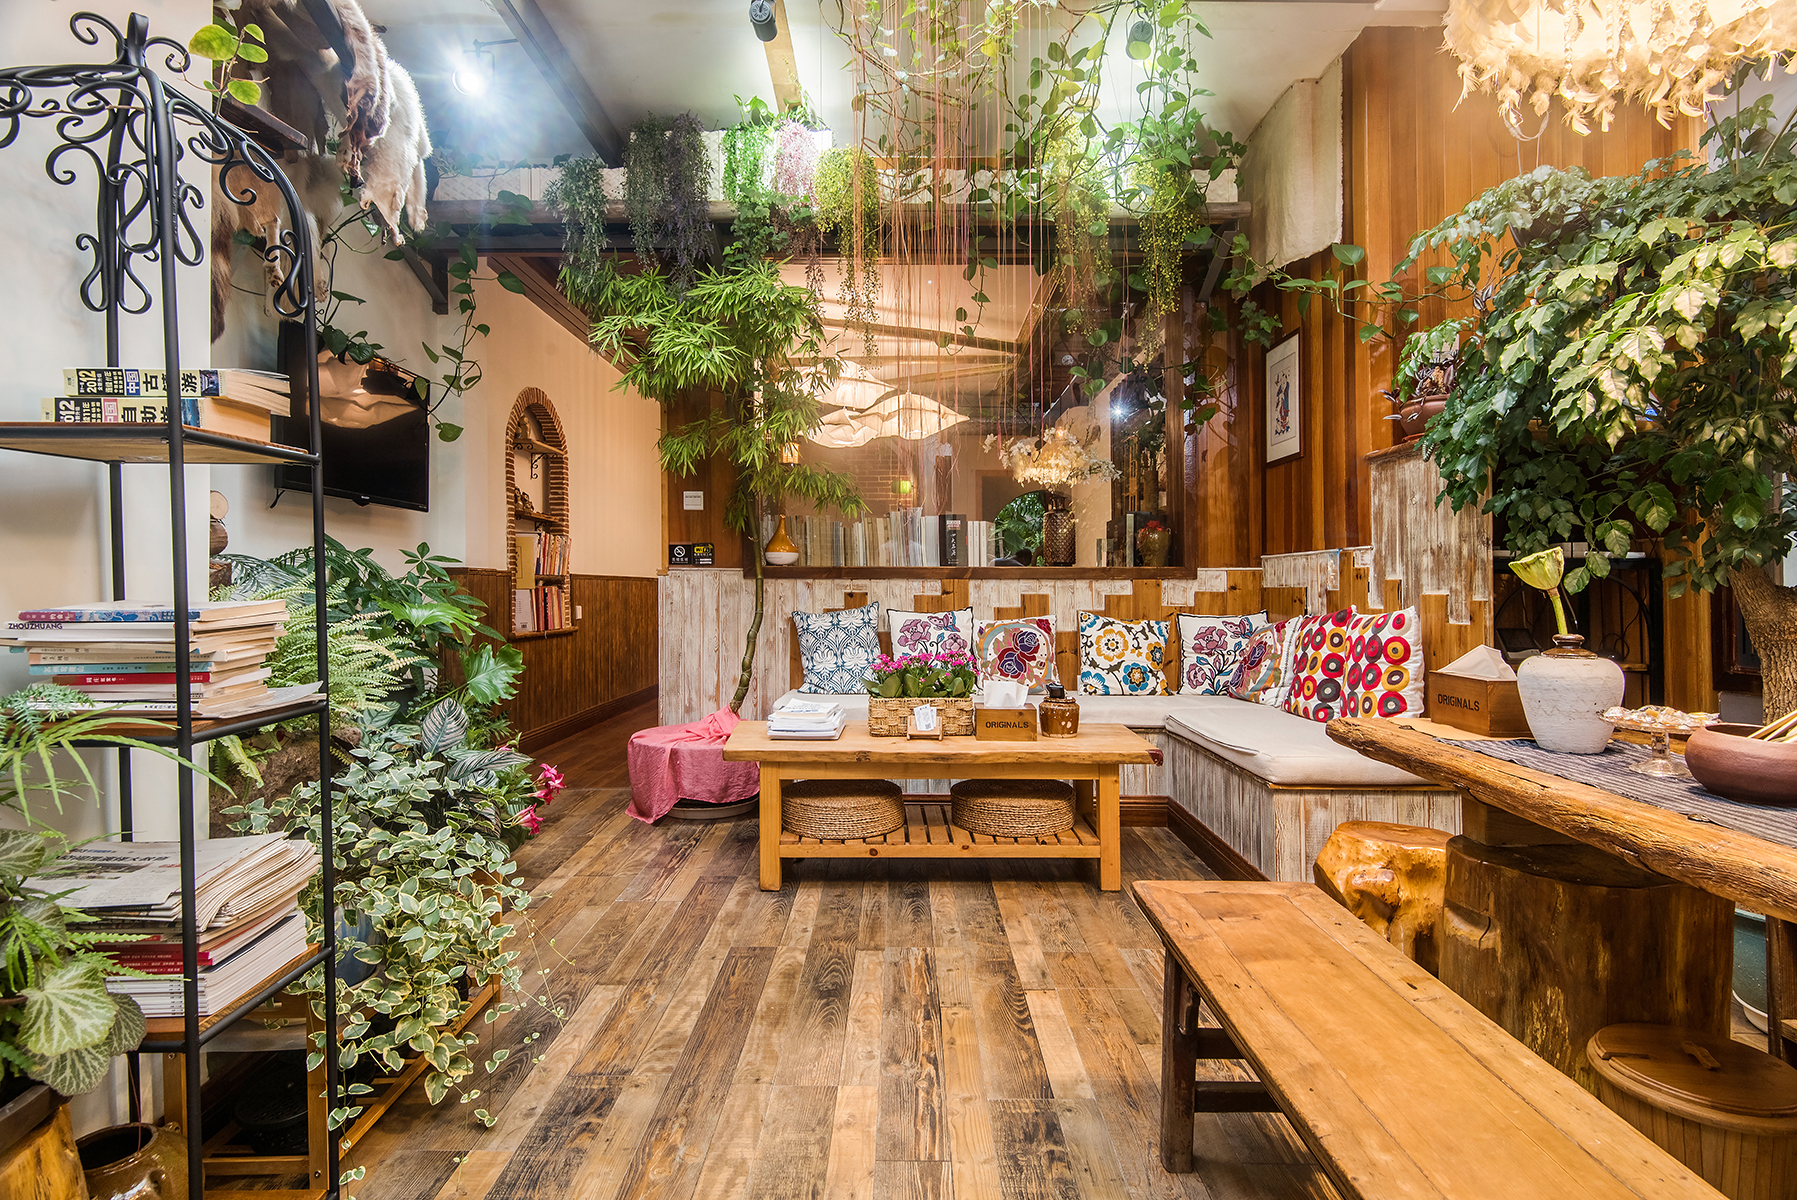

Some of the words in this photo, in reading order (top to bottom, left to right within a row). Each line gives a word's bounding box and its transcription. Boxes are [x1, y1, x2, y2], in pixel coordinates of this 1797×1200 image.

[79, 370, 97, 393] 2012
[126, 371, 139, 394] 中国
[58, 400, 75, 422] 012
[1437, 693, 1480, 711] ORIGINALS
[985, 721, 1029, 729] ORIGINALS
